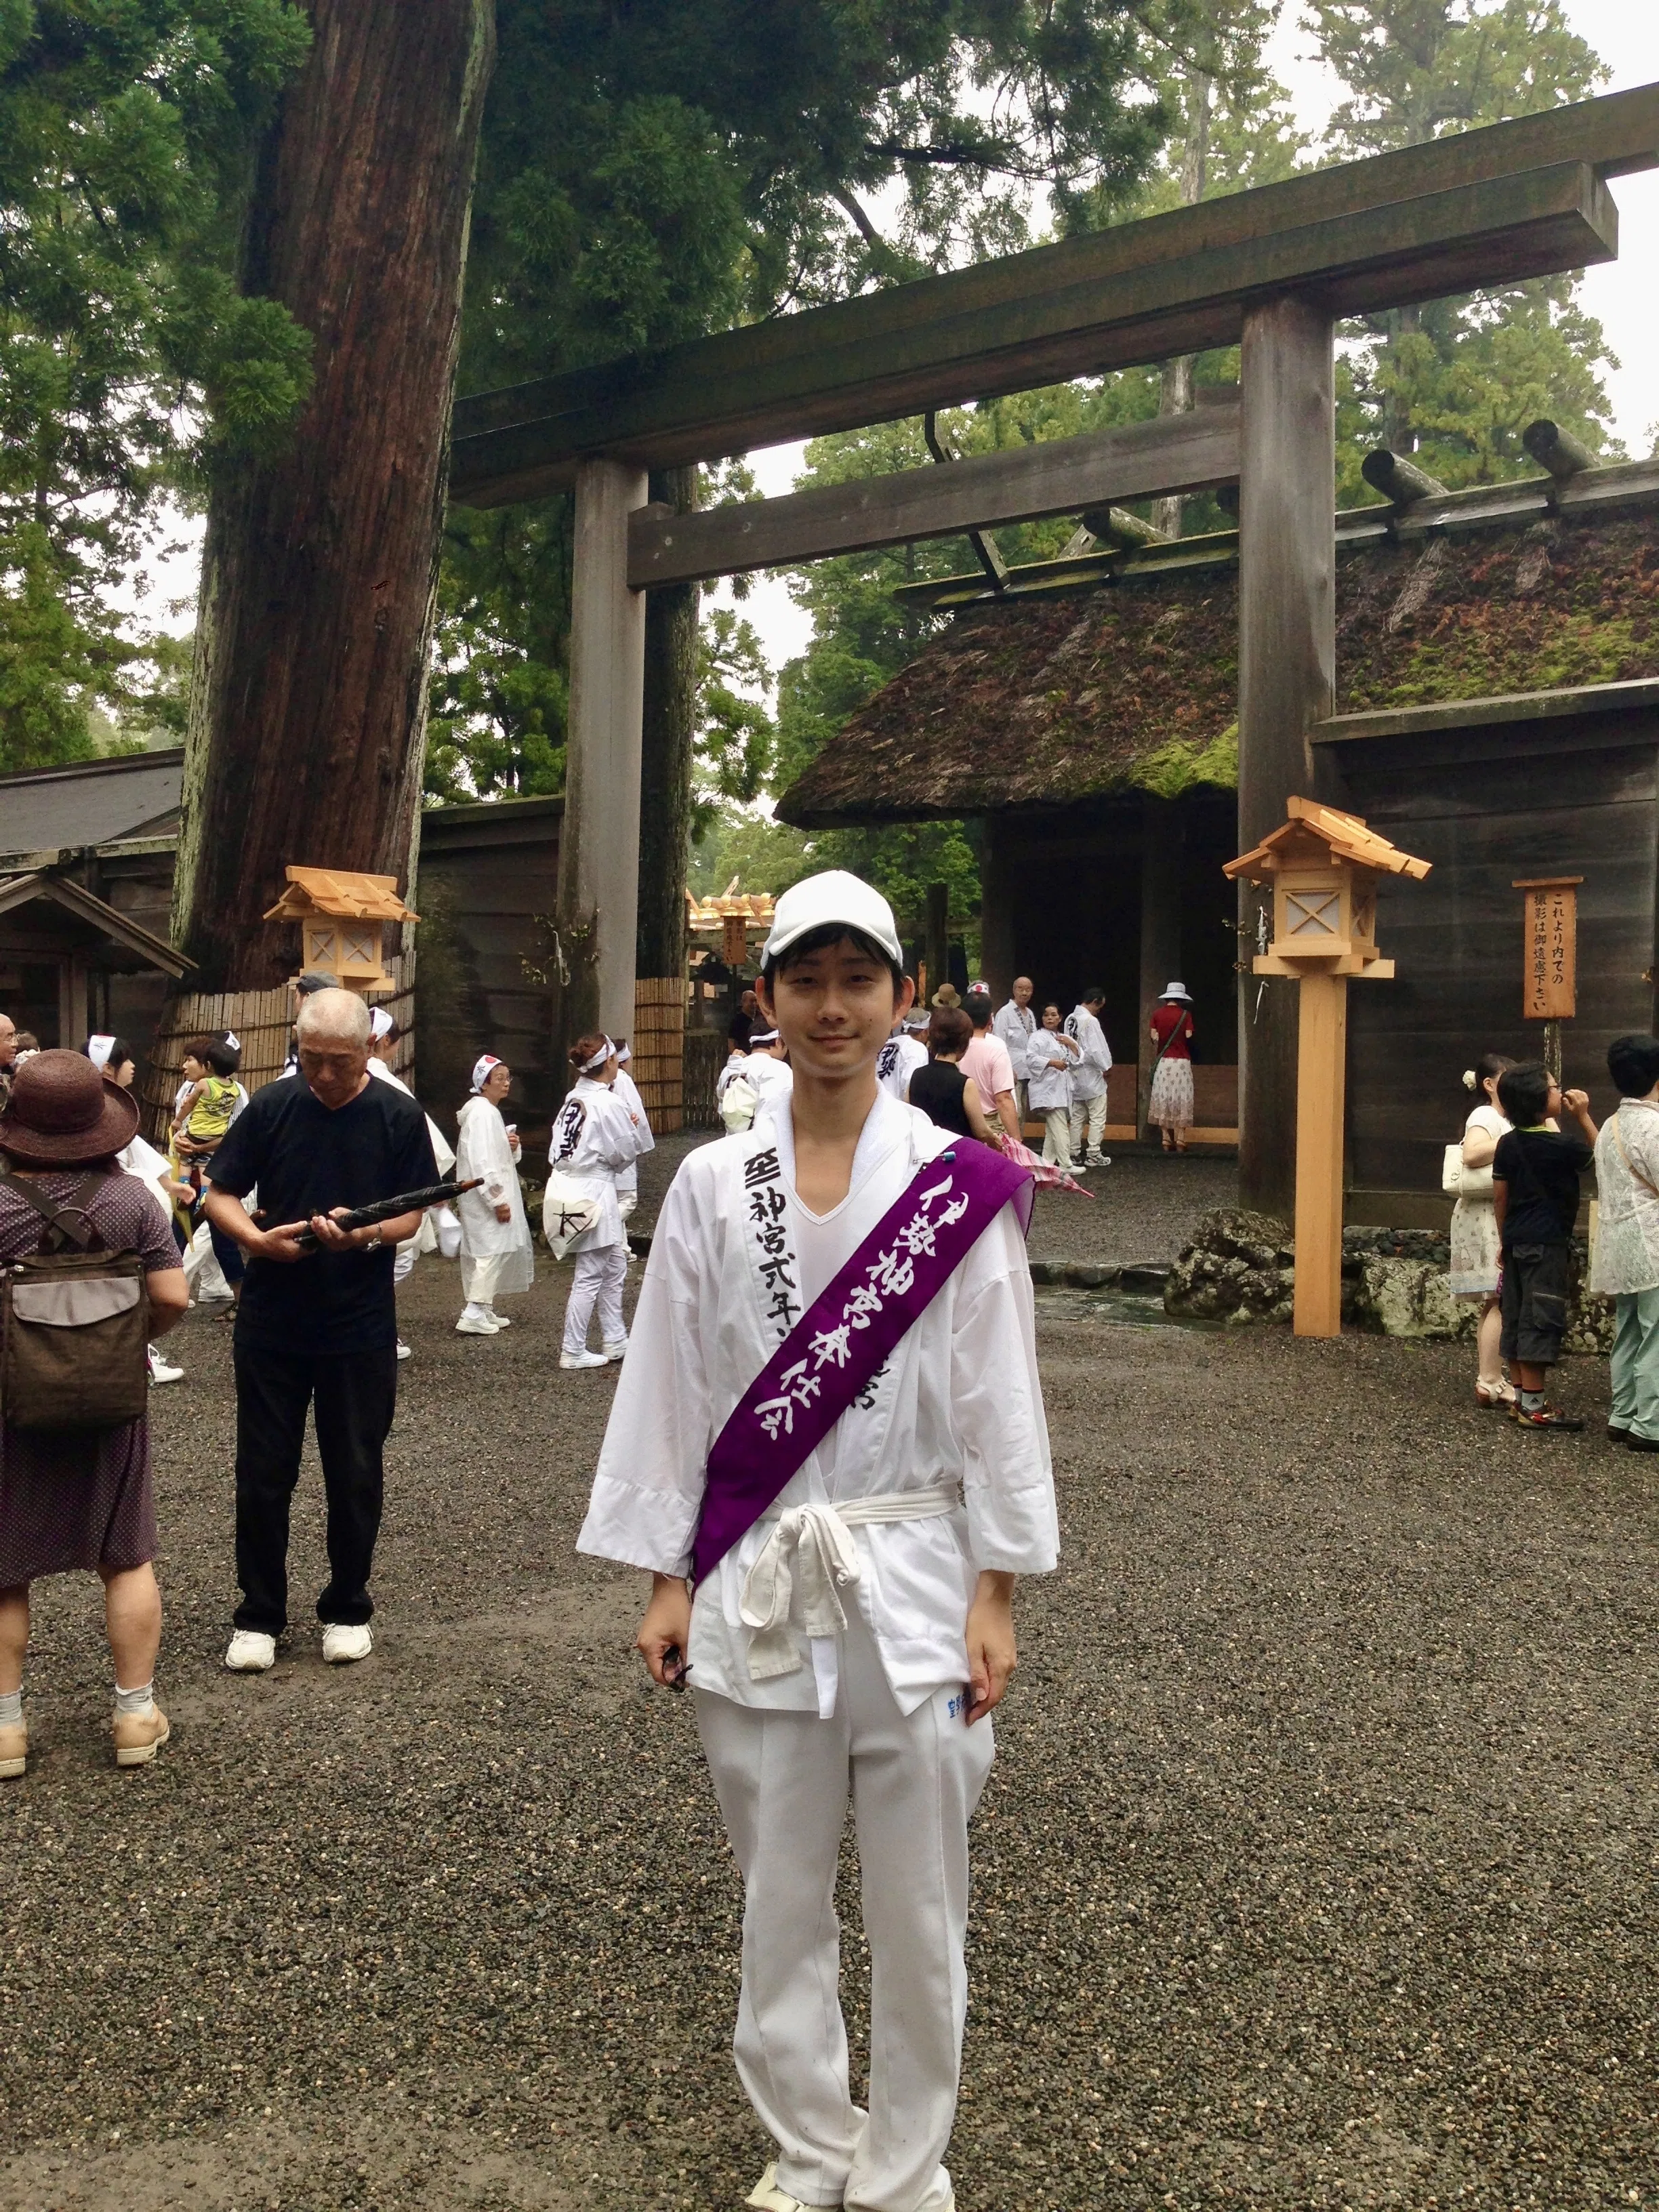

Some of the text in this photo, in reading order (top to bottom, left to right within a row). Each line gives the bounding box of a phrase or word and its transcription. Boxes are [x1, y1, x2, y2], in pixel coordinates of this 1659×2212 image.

[1551, 893, 1565, 984] これより内での
[749, 1186, 801, 1345] 神宮式年
